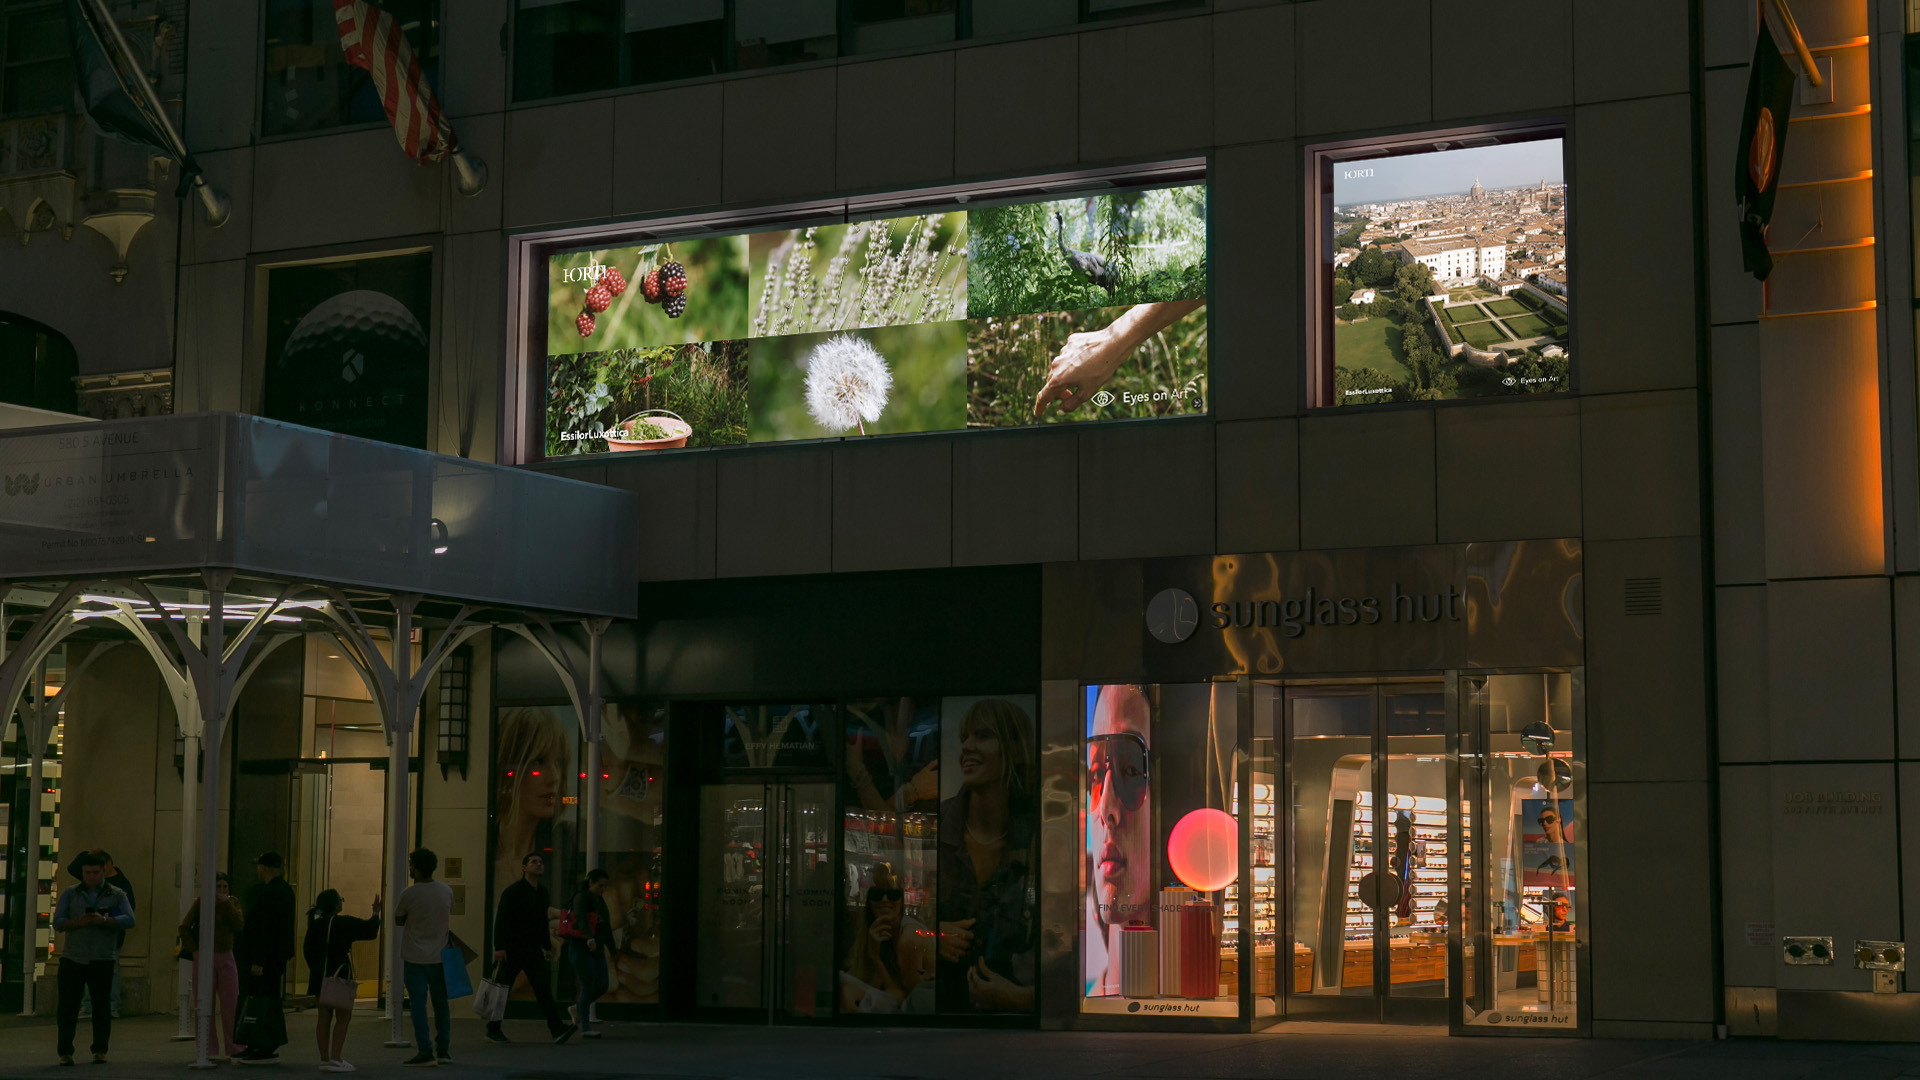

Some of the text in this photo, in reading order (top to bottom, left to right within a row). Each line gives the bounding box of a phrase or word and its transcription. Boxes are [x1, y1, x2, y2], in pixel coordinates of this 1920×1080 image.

[1521, 377, 1537, 386] Eyes
[1123, 388, 1188, 406] Eyes on Art
[299, 393, 409, 412] KONNECT
[59, 437, 80, 449] 580
[93, 432, 139, 447] AVENUE
[561, 430, 629, 441] EssilorLuxottica
[44, 466, 194, 488] URBAN UMBRELLA
[41, 539, 66, 549] Permit
[1208, 583, 1460, 638] sunglass hut
[745, 741, 815, 750] EFFY HEMATIAN
[1817, 791, 1881, 803] BUILDING
[802, 899, 831, 907] SOON
[1151, 904, 1181, 912] SHADE
[1143, 1003, 1200, 1013] sunglass hut
[1505, 1014, 1568, 1024] sunglass hut
